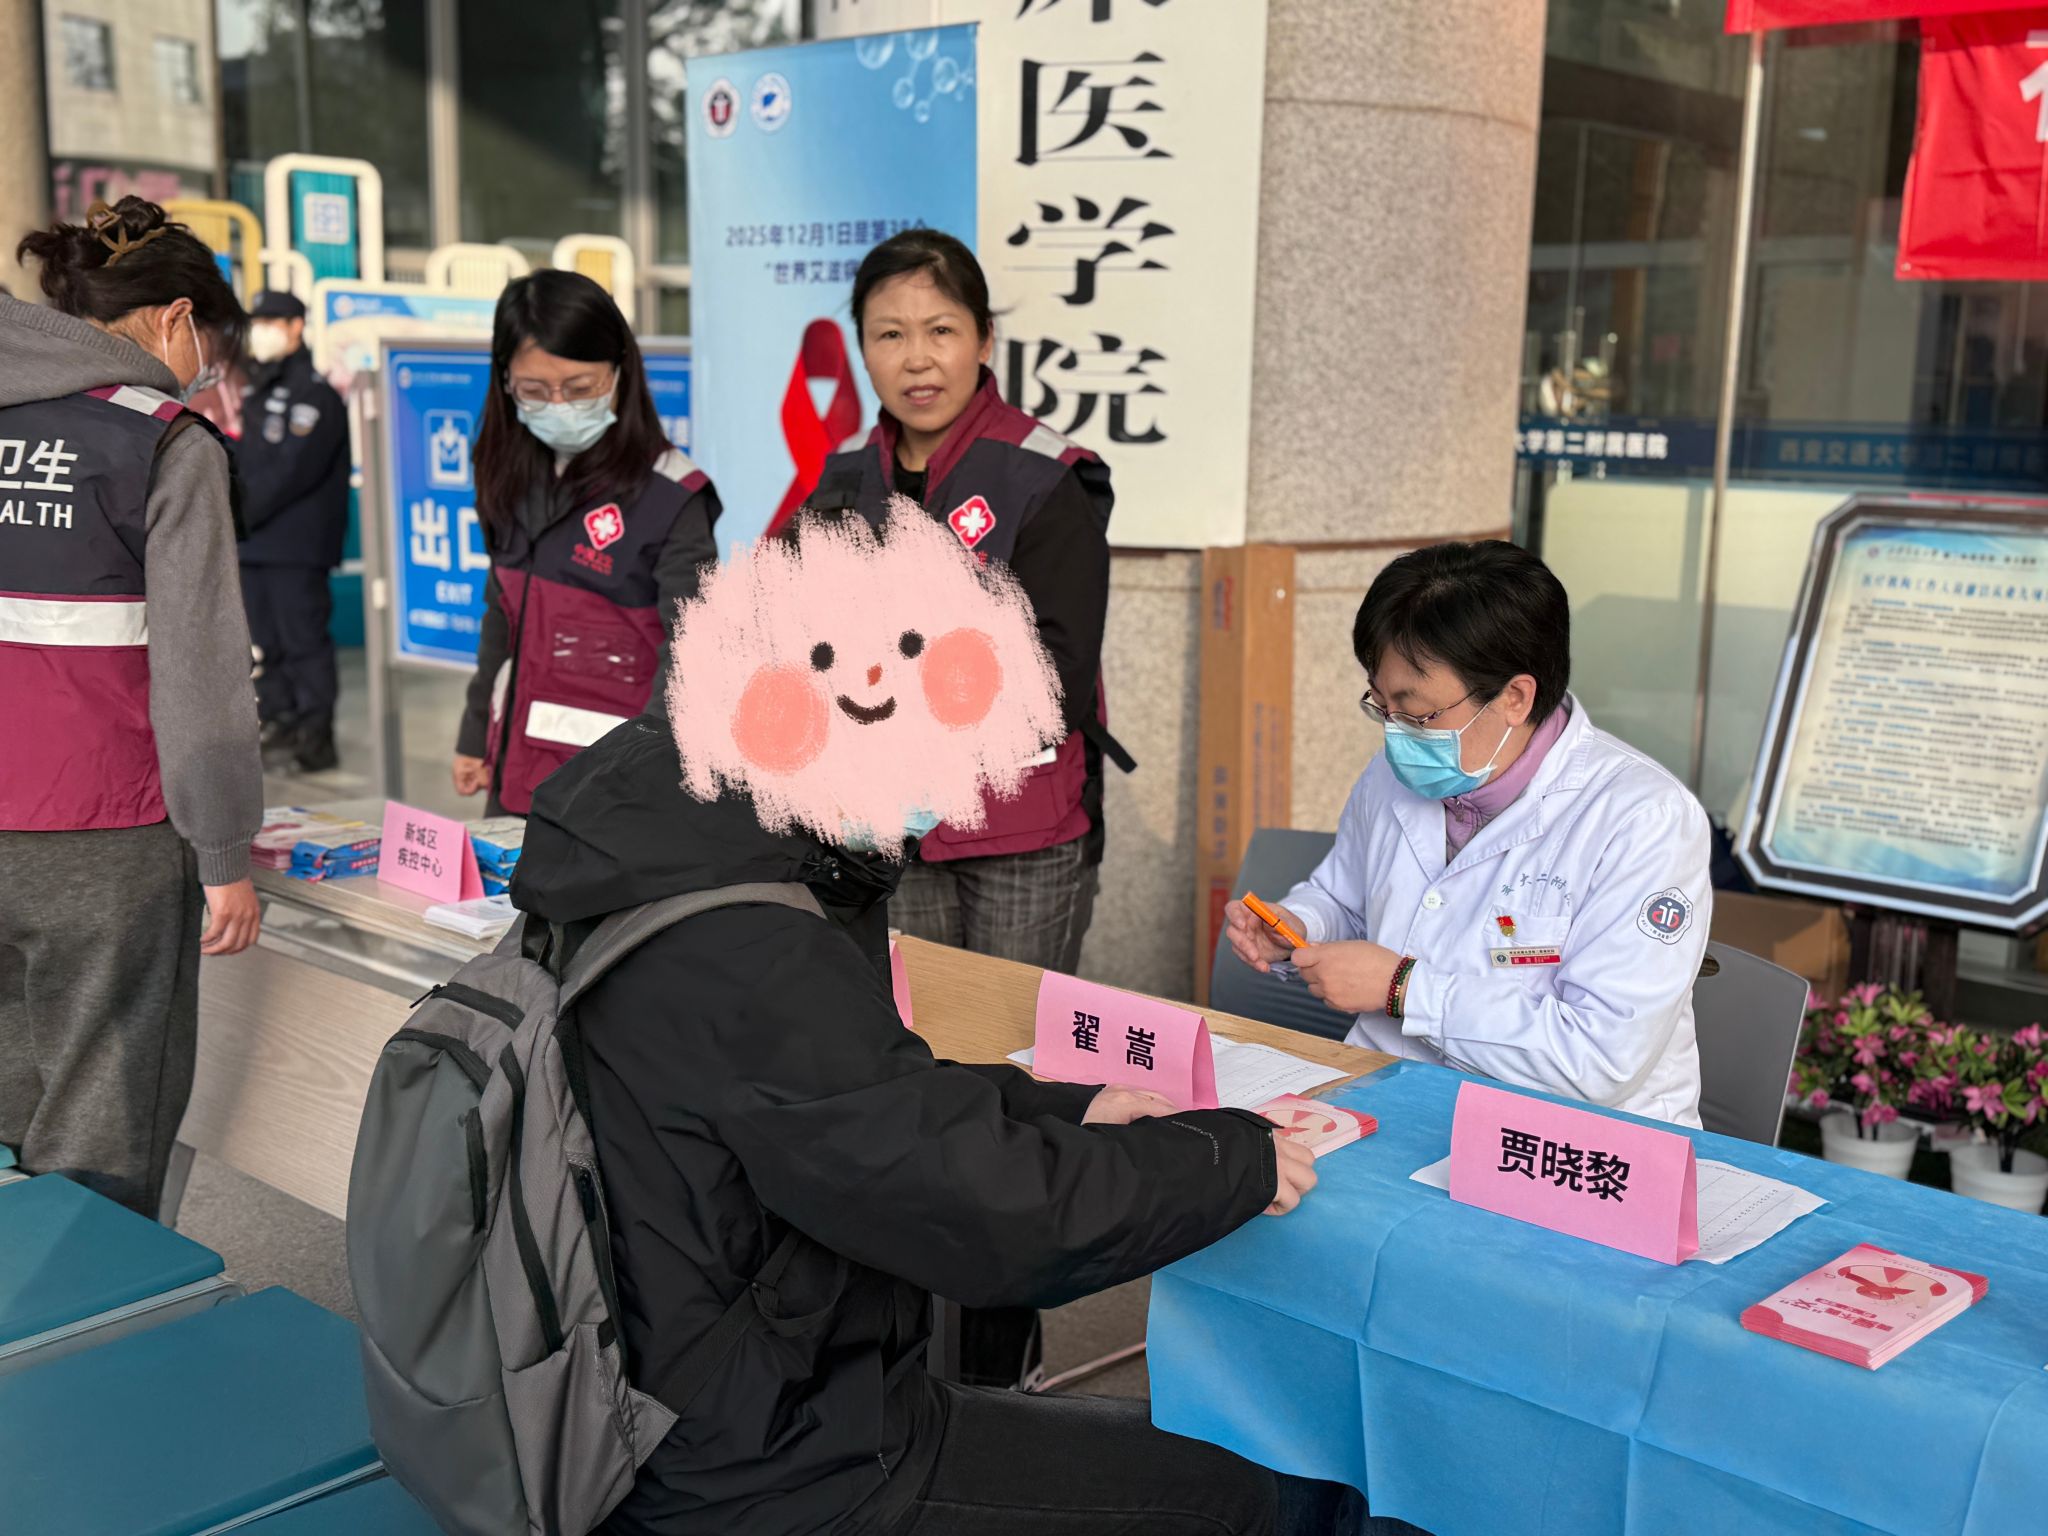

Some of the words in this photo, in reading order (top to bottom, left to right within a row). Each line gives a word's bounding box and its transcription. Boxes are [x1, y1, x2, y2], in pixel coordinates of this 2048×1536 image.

[0, 439, 79, 493] 卫生
[0, 499, 73, 529] ALTH
[404, 823, 438, 849] 新城区
[398, 847, 442, 877] 疾控中心
[1072, 1010, 1100, 1053] 翟
[1126, 1026, 1156, 1071] 嵩
[1497, 1127, 1631, 1203] 贾晓黎
